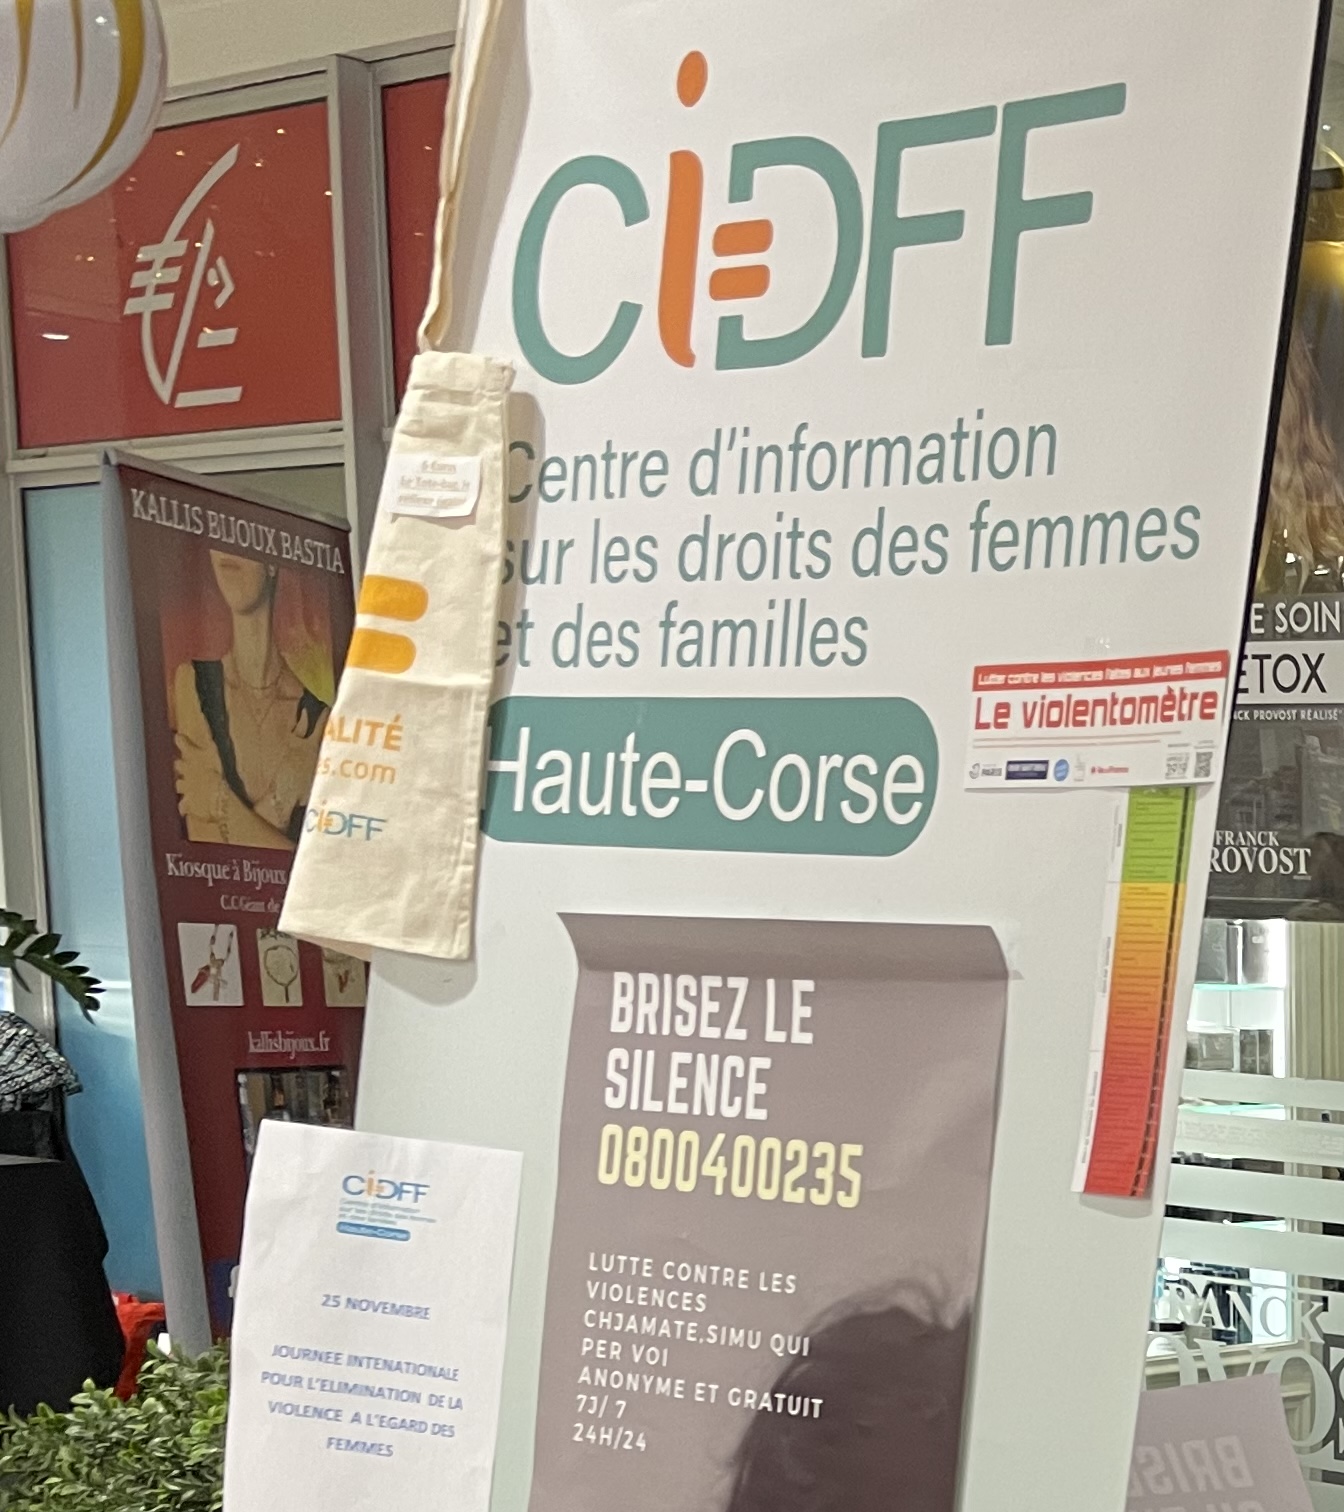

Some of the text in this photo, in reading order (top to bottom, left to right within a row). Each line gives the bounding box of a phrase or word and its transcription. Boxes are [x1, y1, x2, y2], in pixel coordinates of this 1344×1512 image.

[509, 437, 668, 504] Centre
[688, 408, 1058, 499] d'information
[131, 489, 345, 575] KALLIS BIJOUX BASTIA
[501, 500, 1201, 589] sur les droits des femmes
[495, 597, 869, 670] et des familles
[1274, 600, 1342, 634] SOIN
[974, 684, 1219, 731] Le violentomètre
[1253, 709, 1299, 722] PROVOST
[484, 726, 928, 825] Haute-Corse
[1215, 829, 1279, 848] FRANCK
[166, 853, 231, 887] Kiosque
[609, 971, 815, 1046] BRISEZ LE
[604, 1046, 772, 1122] SILENCE
[597, 1123, 864, 1210] 0800400235
[588, 1251, 798, 1295] LUTTE CONTRE LES
[321, 1292, 431, 1321] 25 NOVEMBRE
[586, 1280, 708, 1313] VIOLENCES
[271, 1343, 460, 1382] JOURNEE INTENATIONALE
[581, 1337, 669, 1368] PER VOI
[770, 1333, 811, 1359] QUI
[260, 1370, 464, 1411] POUR L'ELIMINATION DE LA
[576, 1393, 627, 1421] 7J/ 7
[577, 1366, 825, 1420] ANONYME ET GRATUIT
[267, 1400, 456, 1439] VIOLENCE A L'EGARD DES
[572, 1422, 648, 1454] 24H/24
[326, 1436, 394, 1458] FEMMES
